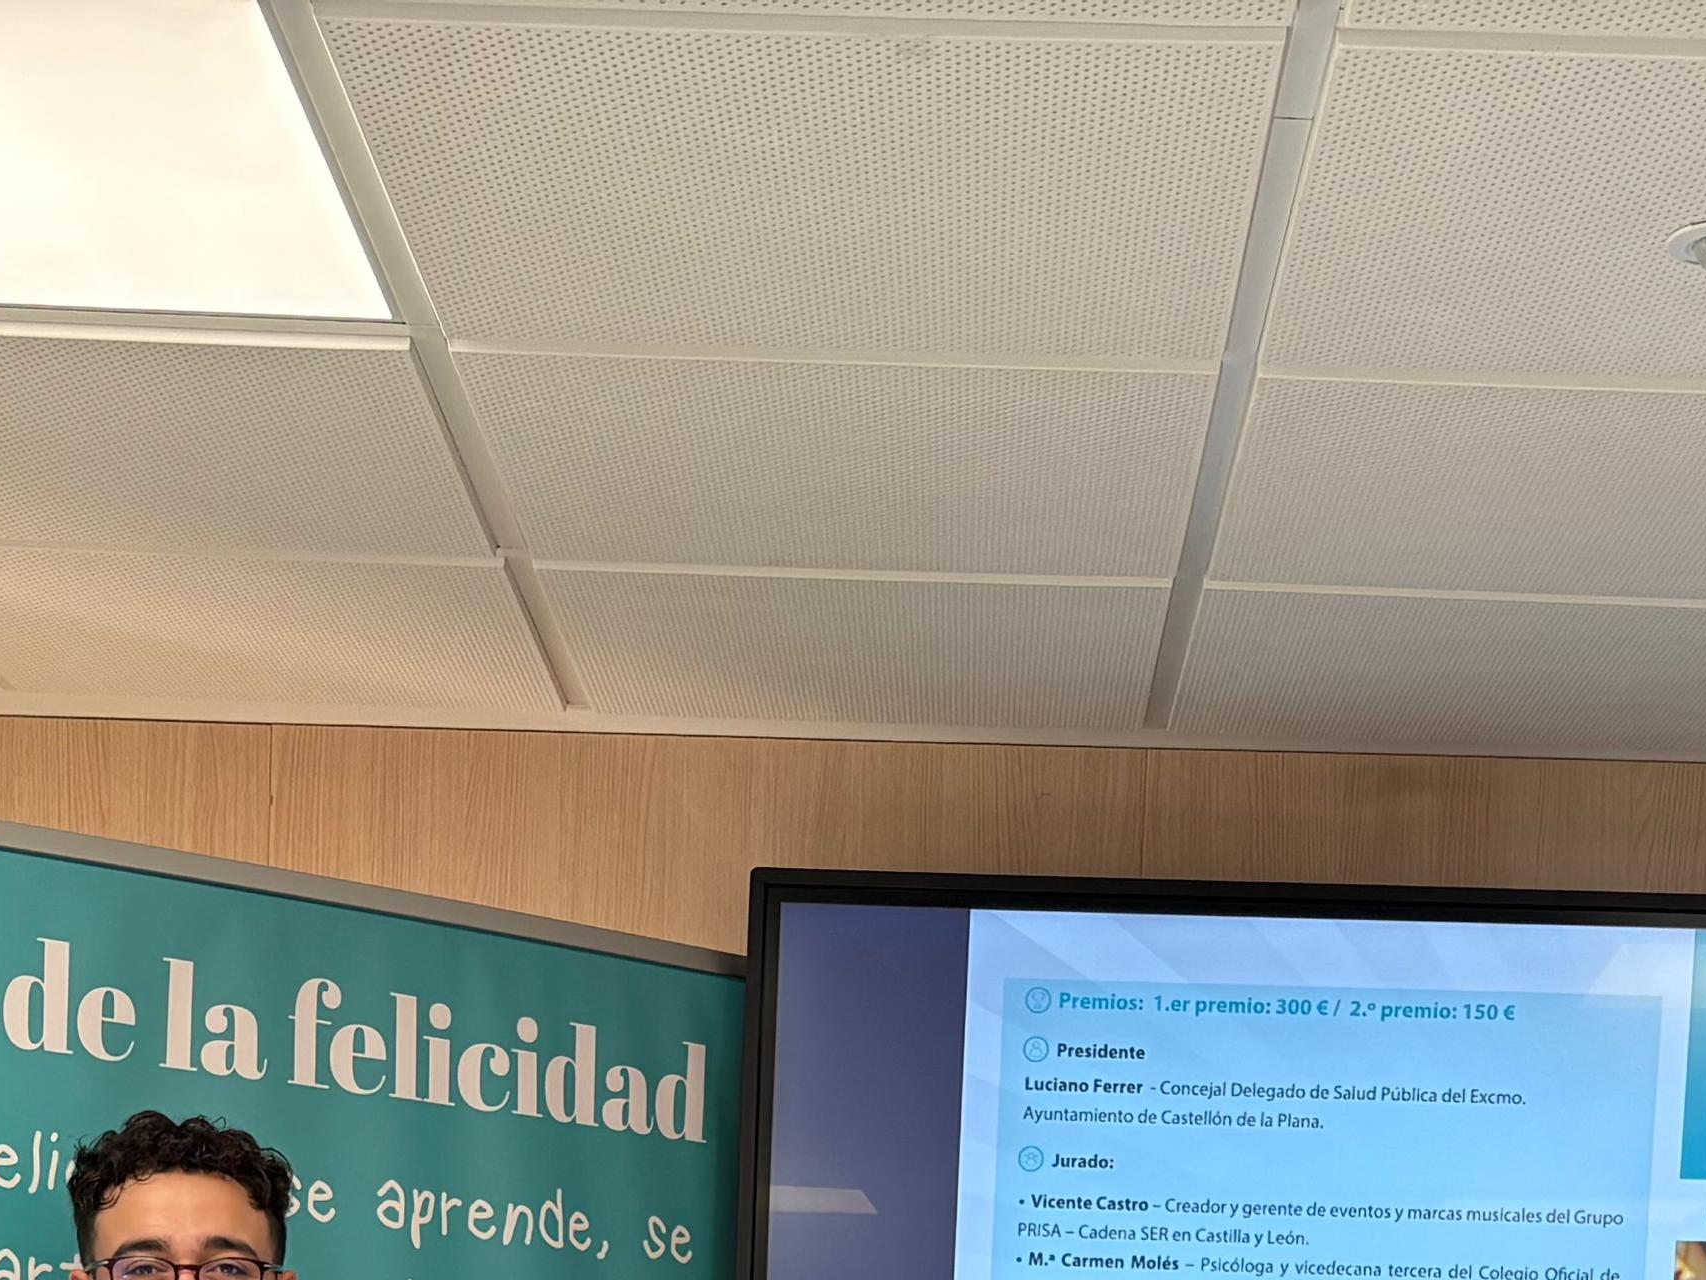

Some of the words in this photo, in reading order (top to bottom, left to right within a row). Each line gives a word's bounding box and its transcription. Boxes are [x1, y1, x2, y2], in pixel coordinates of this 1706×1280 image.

[1059, 991, 1144, 1011] Premios:
[1195, 996, 1271, 1017] premio:
[1275, 998, 1312, 1016] 300
[1316, 999, 1329, 1016] €
[1380, 1001, 1457, 1022] premio:
[1463, 1003, 1499, 1021] 150
[1503, 1004, 1516, 1021] €
[2, 937, 136, 1062] de
[159, 957, 268, 1080] la
[287, 977, 707, 1143] felicidad
[1057, 1042, 1146, 1060] Presidente
[1024, 1076, 1090, 1093] Luciano
[1092, 1078, 1144, 1094] Ferrer
[1159, 1080, 1227, 1100] Concejal
[1230, 1082, 1306, 1102] Delegado
[1309, 1084, 1330, 1100] de
[1333, 1085, 1377, 1101] Salud
[1381, 1086, 1438, 1103] Pública
[1441, 1087, 1466, 1104] del
[1470, 1088, 1526, 1105] Excmo.
[1023, 1105, 1134, 1125] Ayuntamiento
[1137, 1108, 1158, 1125] de
[1160, 1109, 1233, 1127] Castellón
[1236, 1111, 1257, 1127] de
[1260, 1111, 1273, 1128] la
[1277, 1112, 1324, 1129] Plana.
[1051, 1153, 1114, 1169] Jurado:
[376, 1177, 610, 1262] aprende,
[641, 1213, 694, 1266] se
[1030, 1193, 1093, 1210] Vicente
[1095, 1195, 1149, 1212] Castro
[1164, 1197, 1227, 1214] Creador
[1229, 1203, 1240, 1219] y
[1241, 1202, 1303, 1219] gerente
[1306, 1201, 1327, 1217] de
[1329, 1205, 1391, 1219] eventos
[1394, 1207, 1404, 1223] y
[1407, 1208, 1463, 1221] marcas
[1466, 1207, 1543, 1224] musicales
[1545, 1208, 1571, 1224] del
[1573, 1209, 1624, 1229] Grupo
[1017, 1222, 1062, 1238] PRISA
[1078, 1224, 1136, 1241] Cadena
[1140, 1225, 1169, 1242] SER
[1172, 1230, 1192, 1242] en
[1195, 1227, 1251, 1244] Castilla
[1254, 1233, 1264, 1248] y
[1267, 1229, 1309, 1246] León.
[1061, 1252, 1125, 1269] Carmen
[1130, 1254, 1180, 1271] Molés
[1200, 1257, 1274, 1277] Psicóloga
[1279, 1263, 1289, 1278] y
[1294, 1260, 1382, 1277] vicedecana
[1388, 1264, 1442, 1279] tercera
[1448, 1263, 1472, 1280] del
